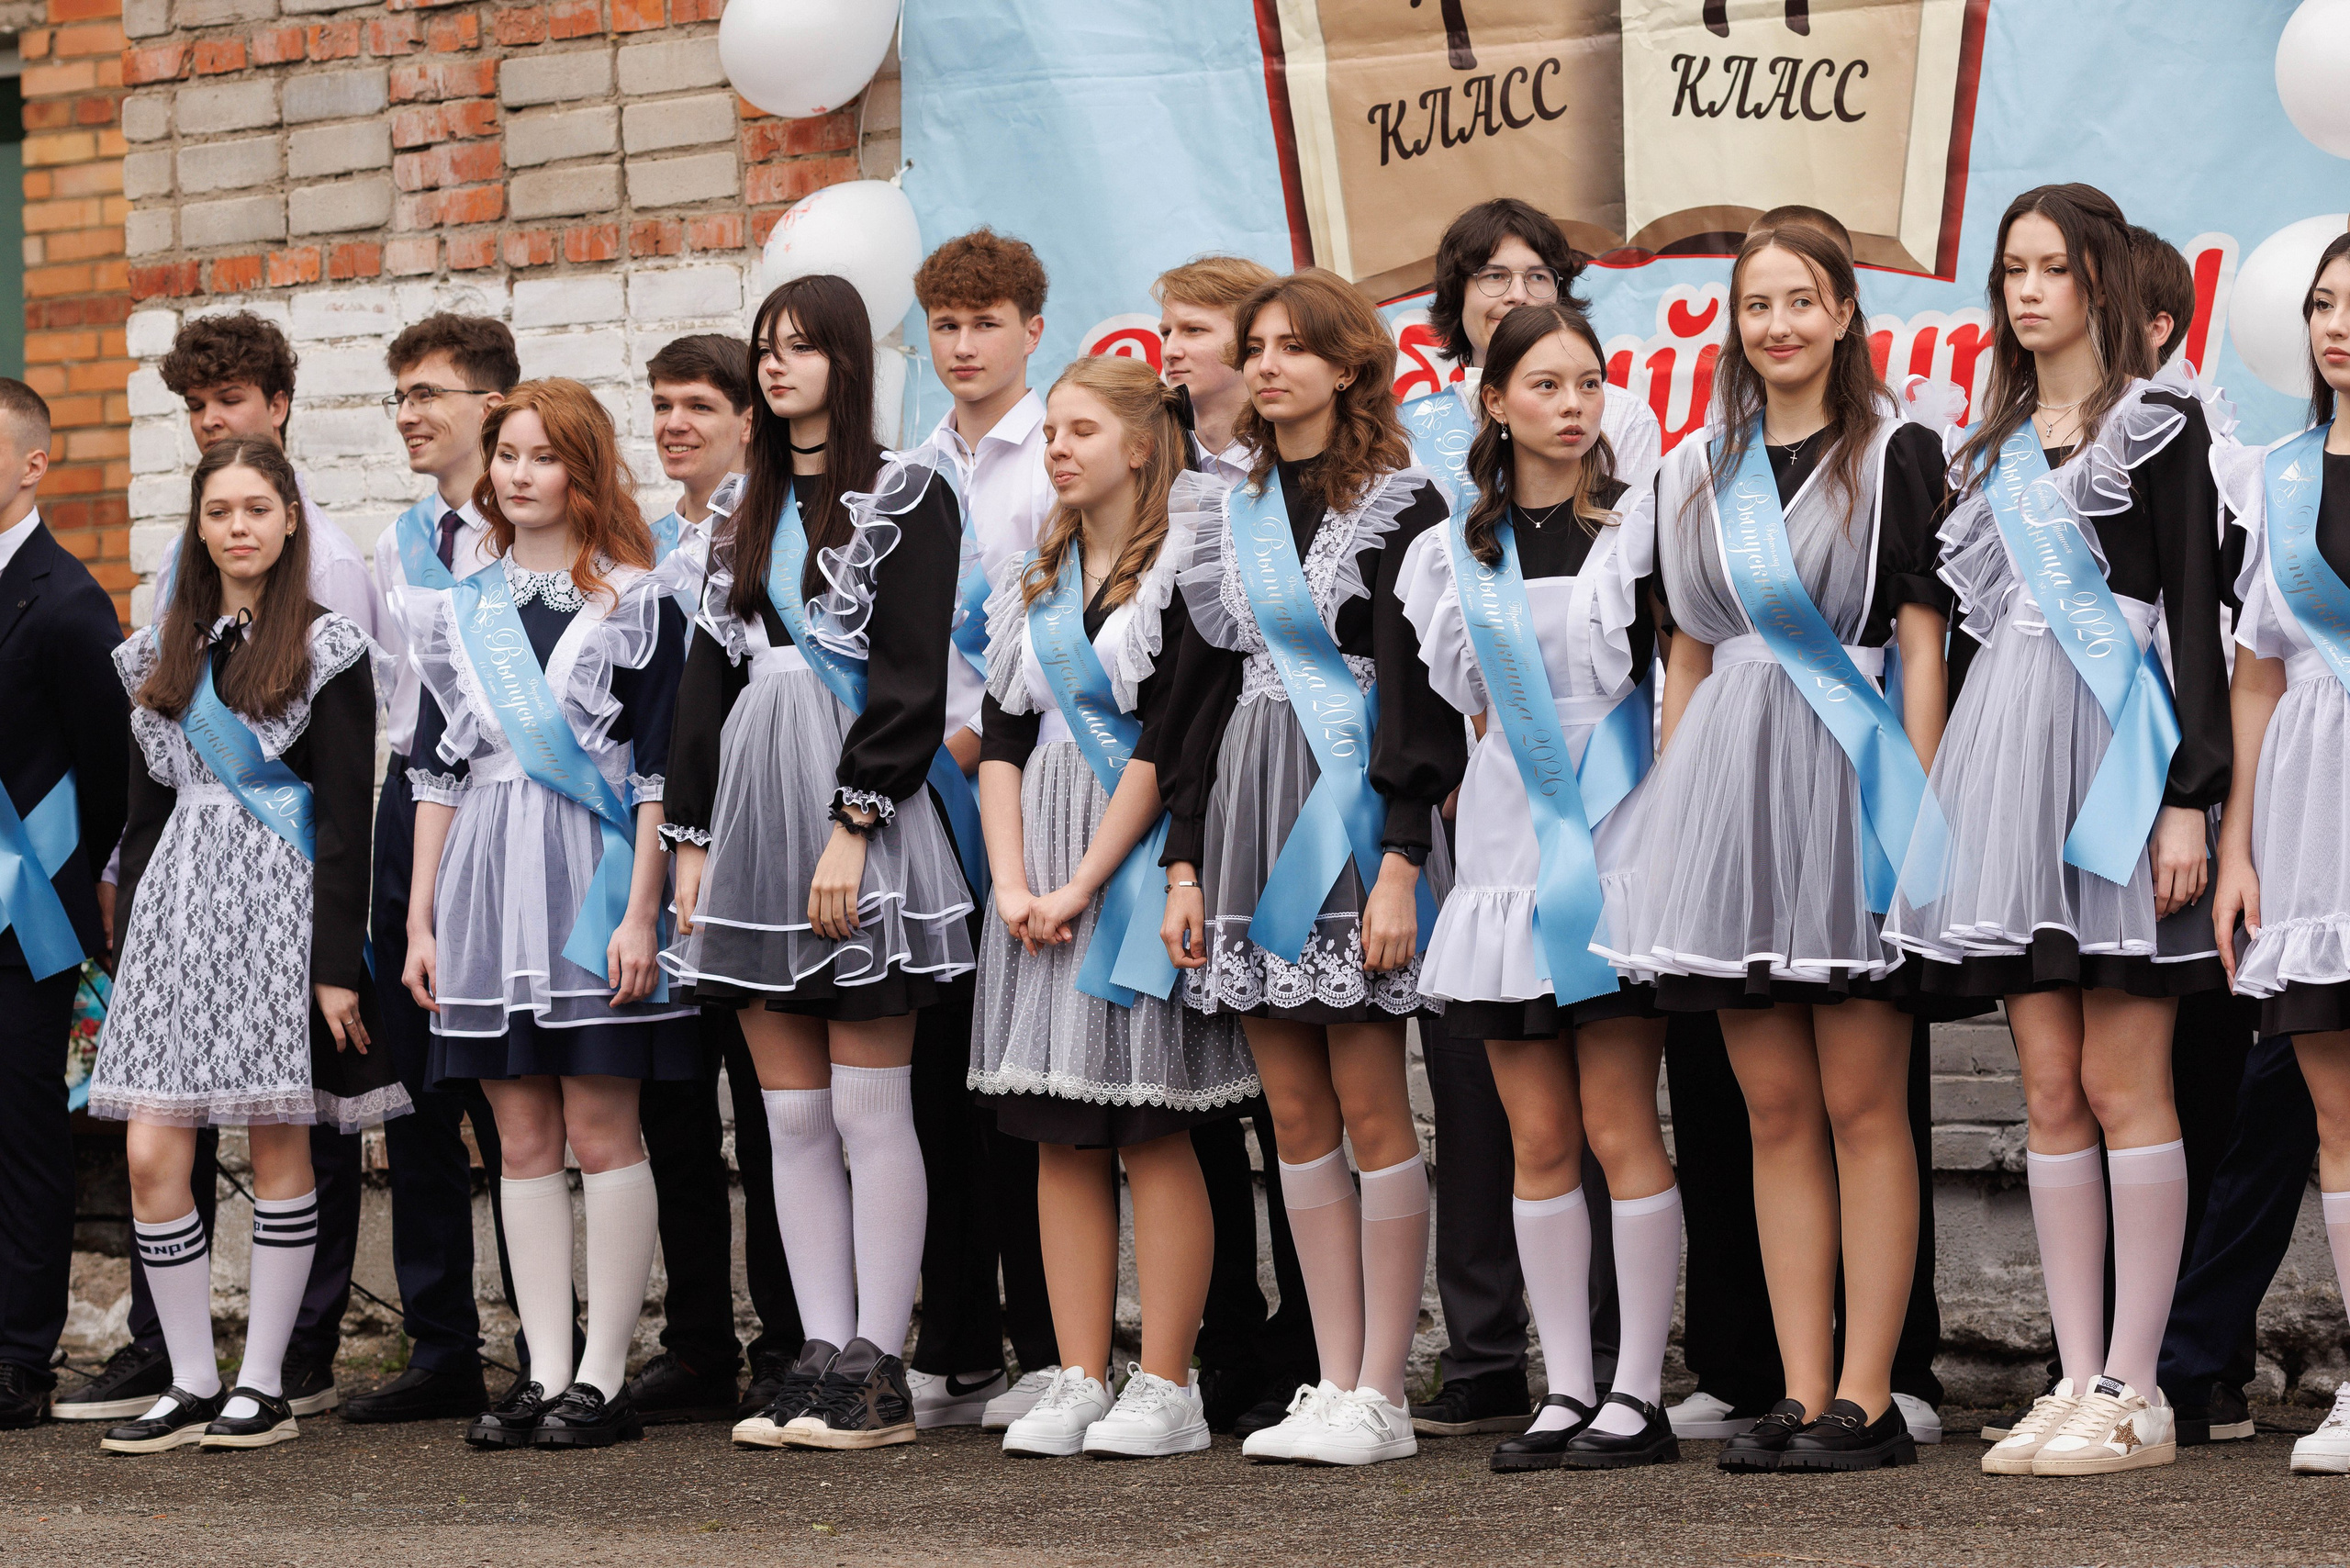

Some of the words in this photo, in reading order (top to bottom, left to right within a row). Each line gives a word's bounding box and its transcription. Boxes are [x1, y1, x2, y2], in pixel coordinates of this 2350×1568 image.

[1368, 57, 1568, 166] КЛАСС
[1670, 53, 1869, 122] КЛАСС
[1247, 515, 1328, 693] Выпускница
[1310, 692, 1368, 757] 2026
[1726, 475, 1803, 640] Выпускница
[1795, 639, 1862, 699] 2026
[2056, 589, 2125, 658] 2026
[482, 626, 569, 781] Выпускница
[1041, 586, 1119, 748] Выпускница
[1521, 727, 1569, 796] 2026
